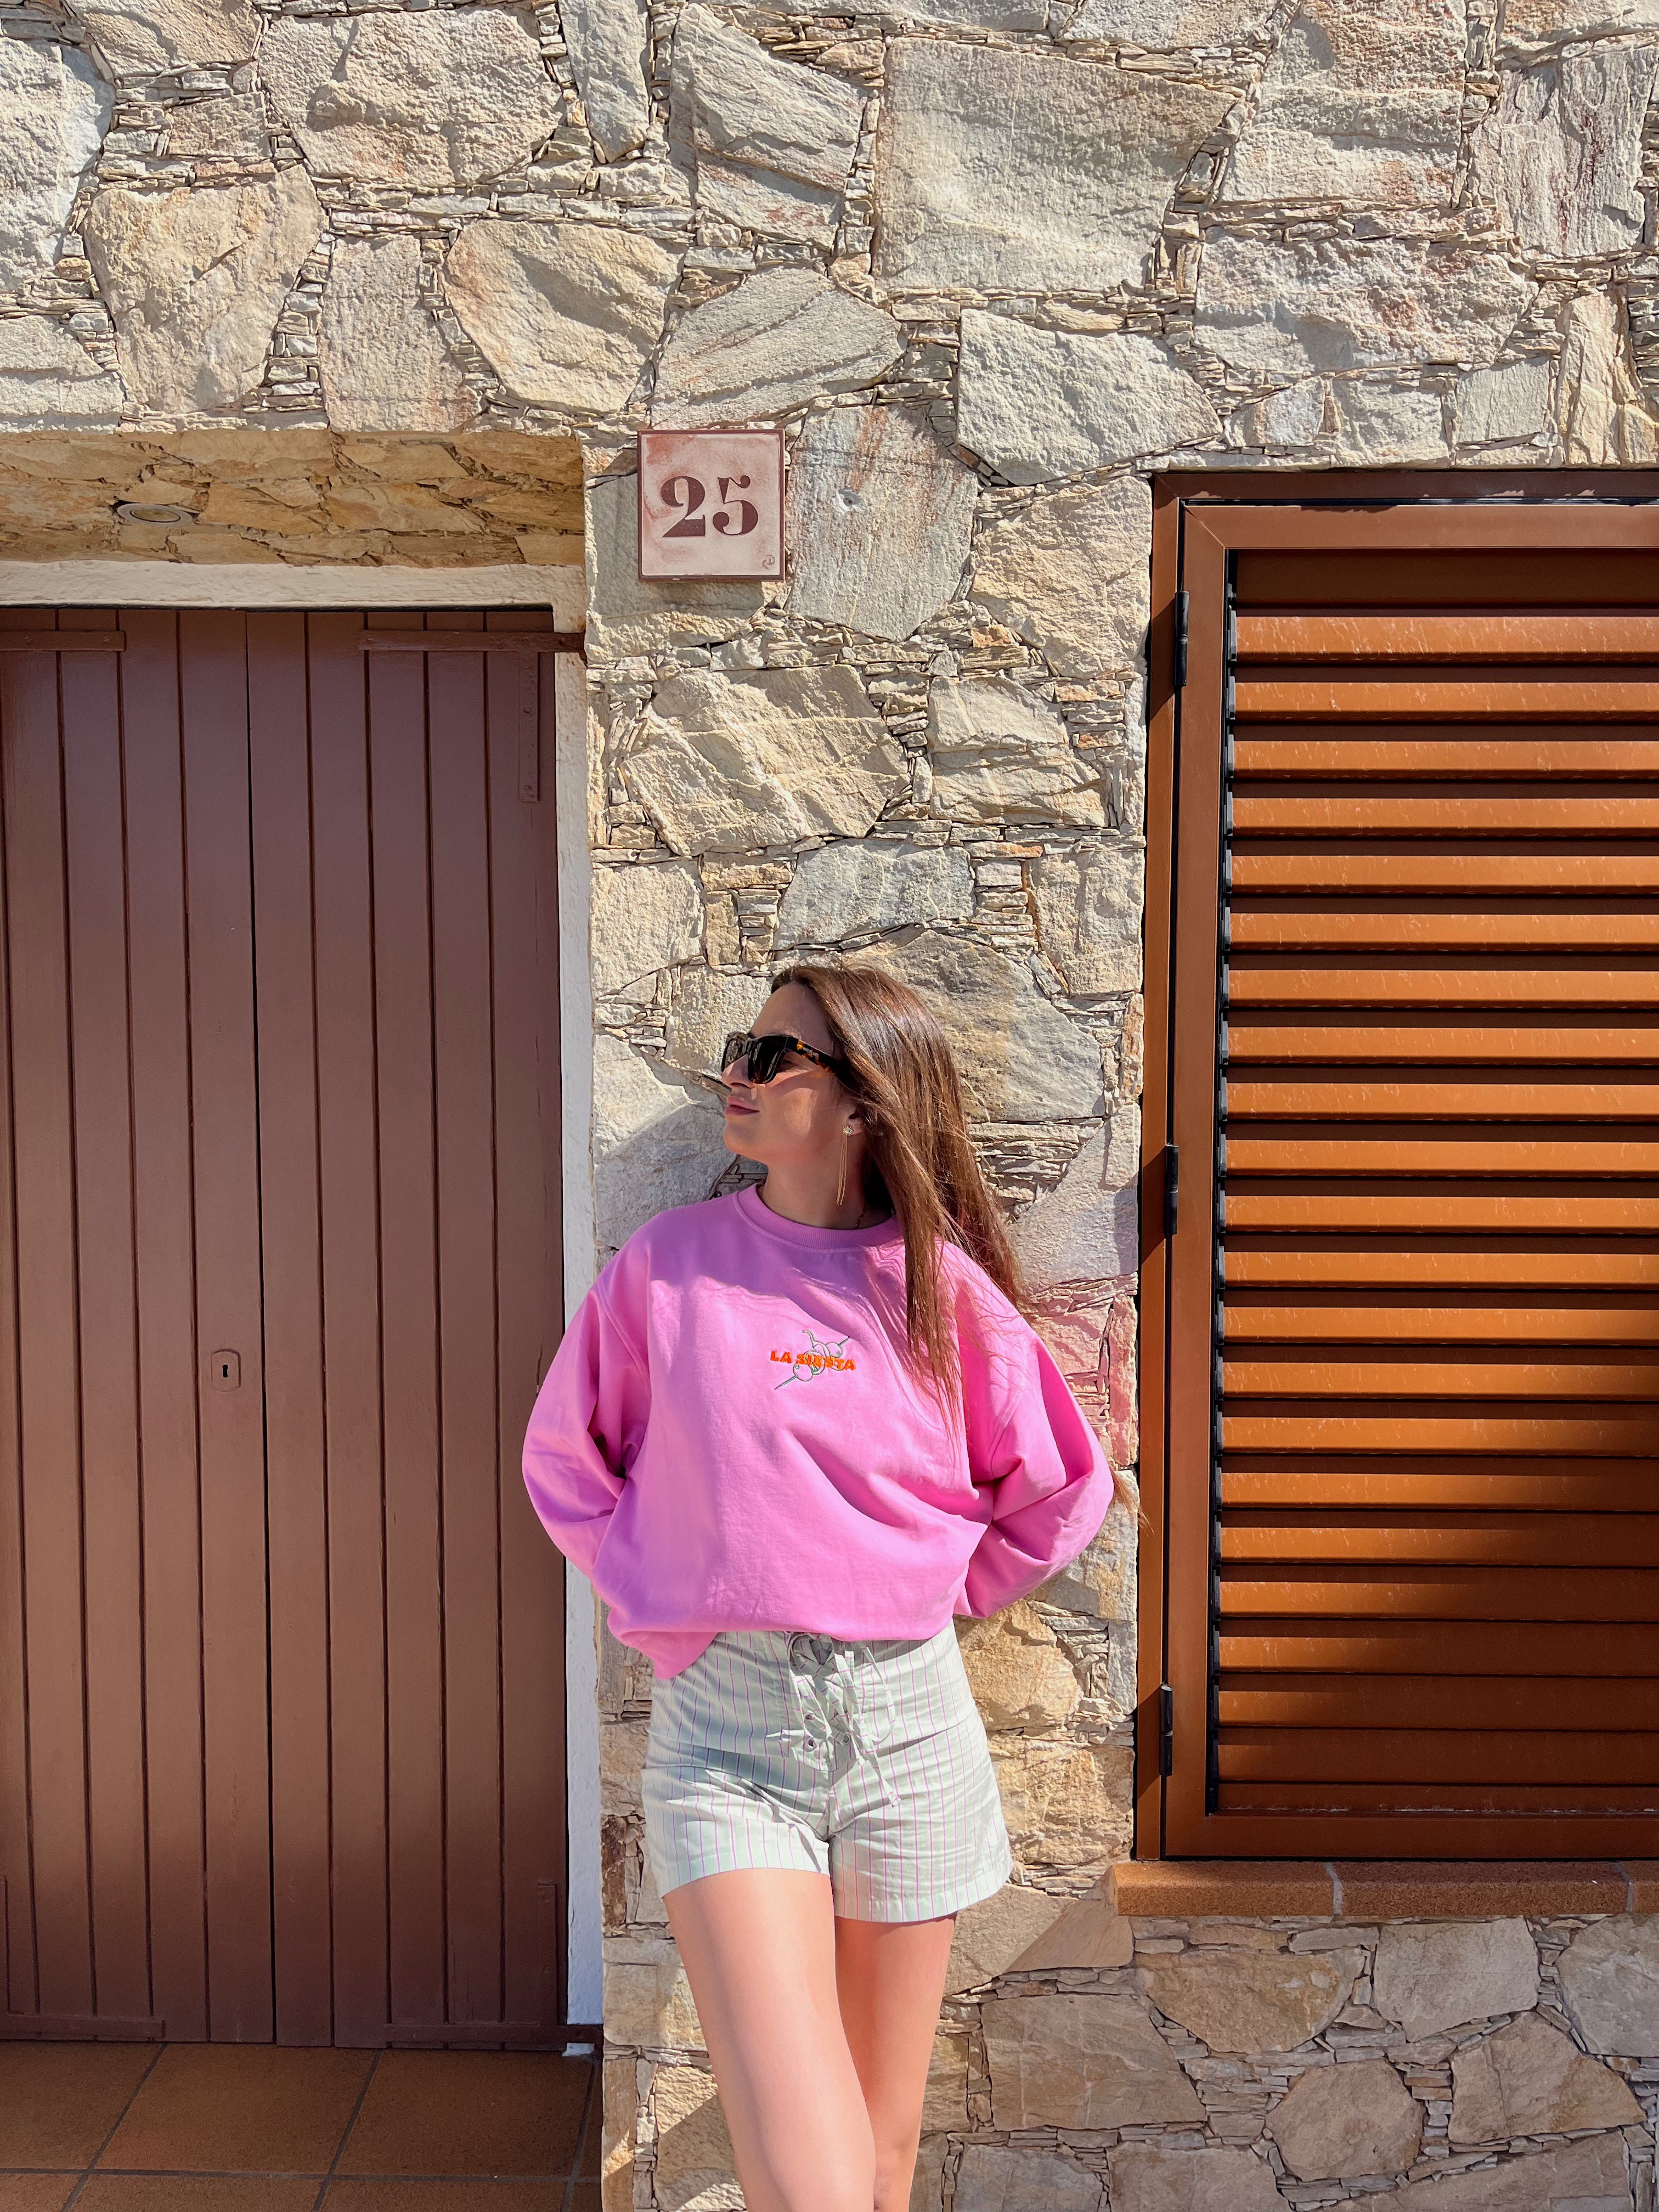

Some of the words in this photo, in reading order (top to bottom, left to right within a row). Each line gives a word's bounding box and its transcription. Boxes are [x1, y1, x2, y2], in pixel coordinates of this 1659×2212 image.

[661, 475, 759, 538] 25
[770, 1350, 792, 1364] LA
[795, 1353, 856, 1370] SIESTA
